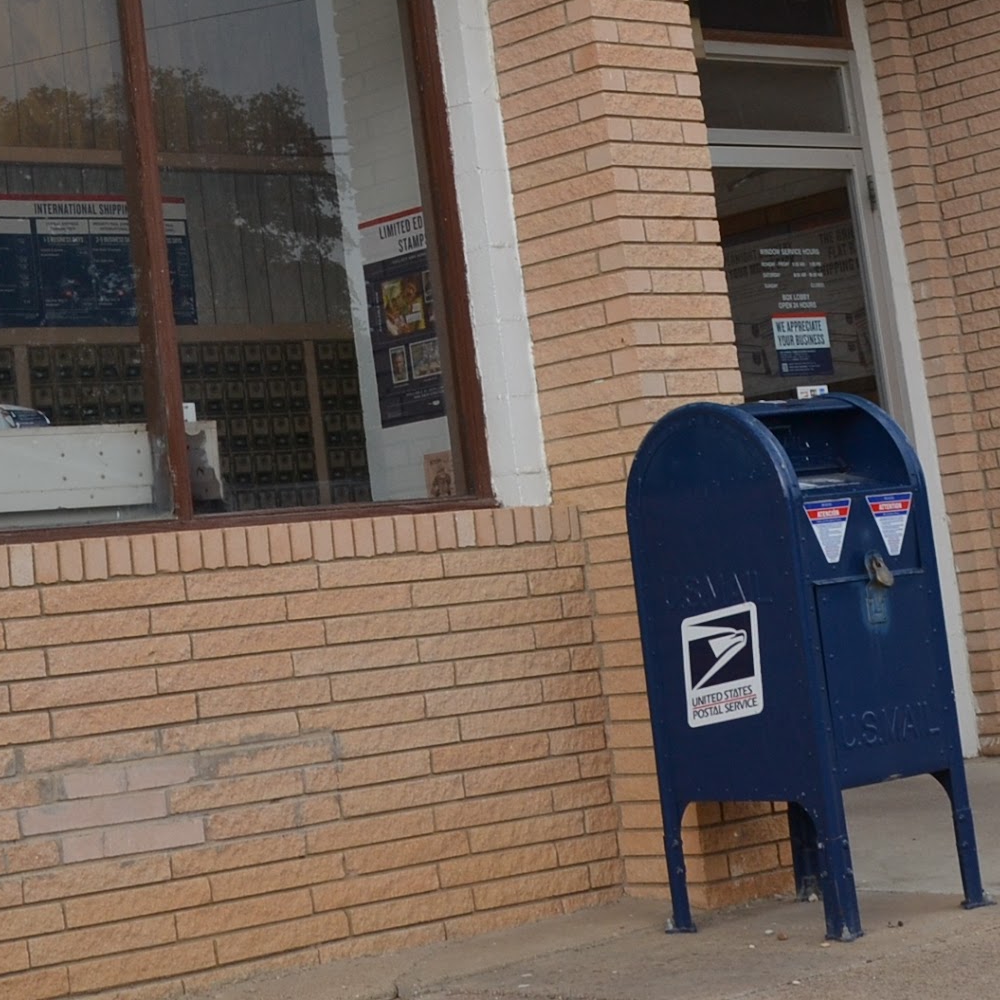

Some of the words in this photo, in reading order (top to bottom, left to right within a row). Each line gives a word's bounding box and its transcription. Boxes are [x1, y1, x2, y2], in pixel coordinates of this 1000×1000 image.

[34, 202, 96, 215] INTERNATIONAL
[98, 203, 129, 216] SHIPPIN
[378, 218, 411, 240] LIMITED
[412, 215, 423, 230] ED
[398, 233, 425, 253] STAMP
[793, 293, 810, 301] LOBBY
[778, 301, 793, 309] OPEN
[799, 301, 817, 309] HOURS
[775, 321, 786, 333] WE
[786, 320, 822, 333] APPRECIATE
[777, 334, 795, 346] YOUR
[795, 334, 825, 346] BUSINESS
[691, 691, 723, 707] UNITED
[723, 685, 753, 700] STATES
[692, 705, 724, 720] POSTAL
[724, 697, 758, 713] SERVICE
